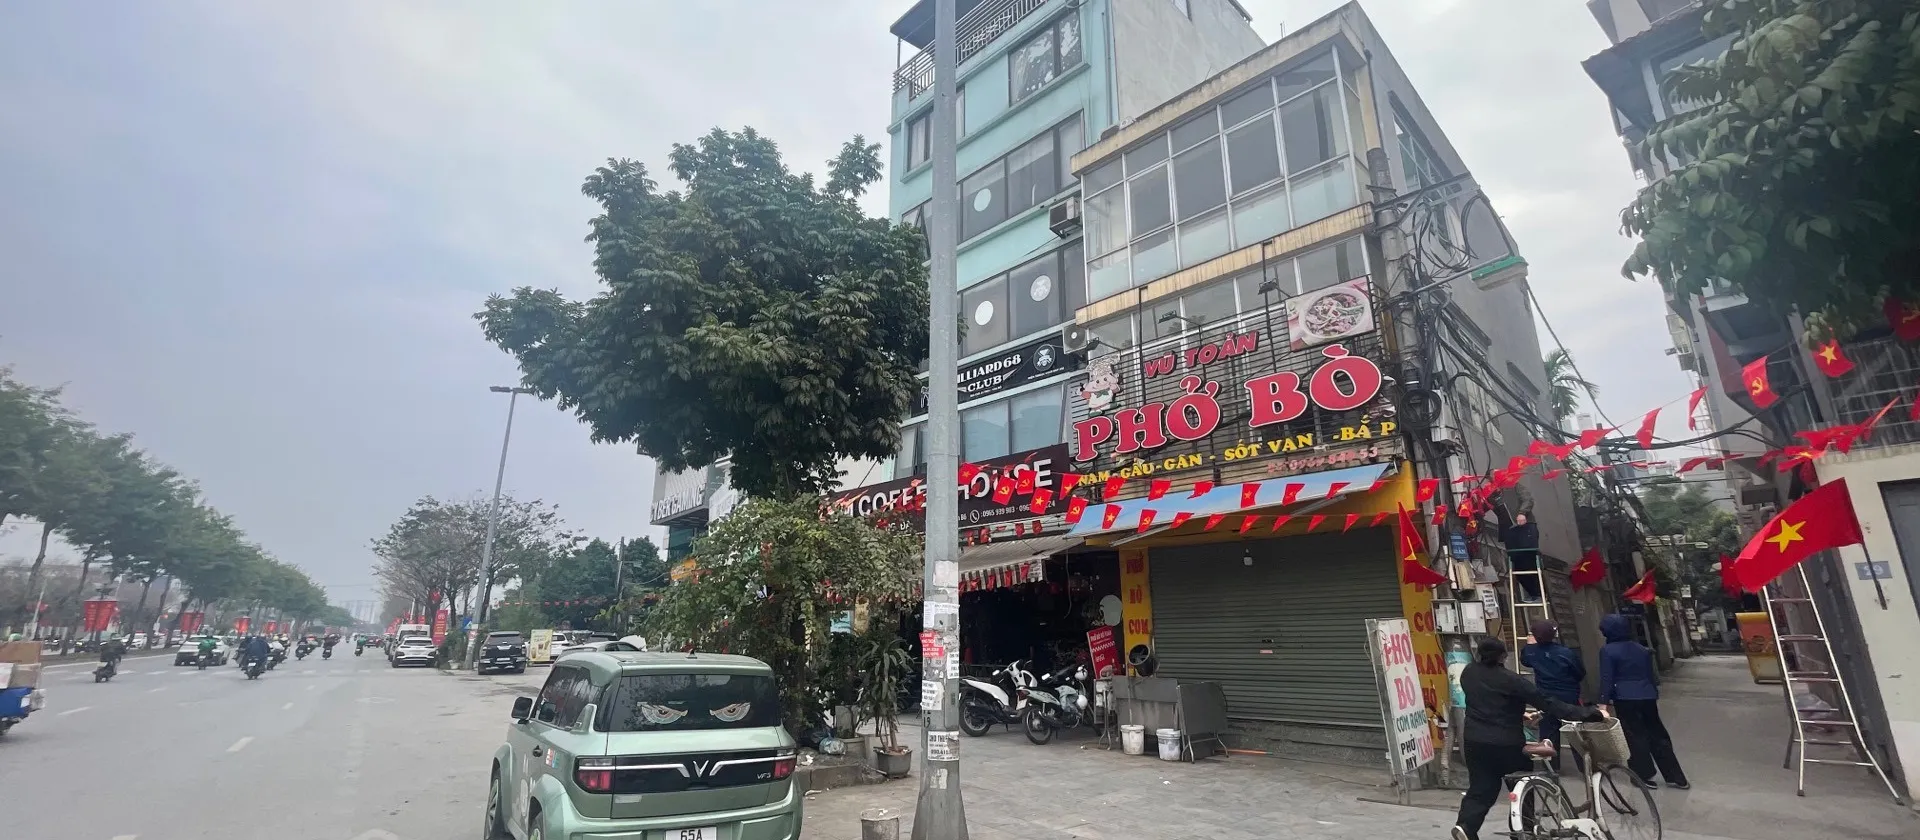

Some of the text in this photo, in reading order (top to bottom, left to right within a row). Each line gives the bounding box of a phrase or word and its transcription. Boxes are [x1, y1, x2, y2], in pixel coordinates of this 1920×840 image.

[957, 361, 1003, 383] ILLIARD
[968, 375, 1003, 392] CLUB
[1073, 344, 1382, 462] PHỞ BÒ
[1394, 667, 1416, 711] BÒ
